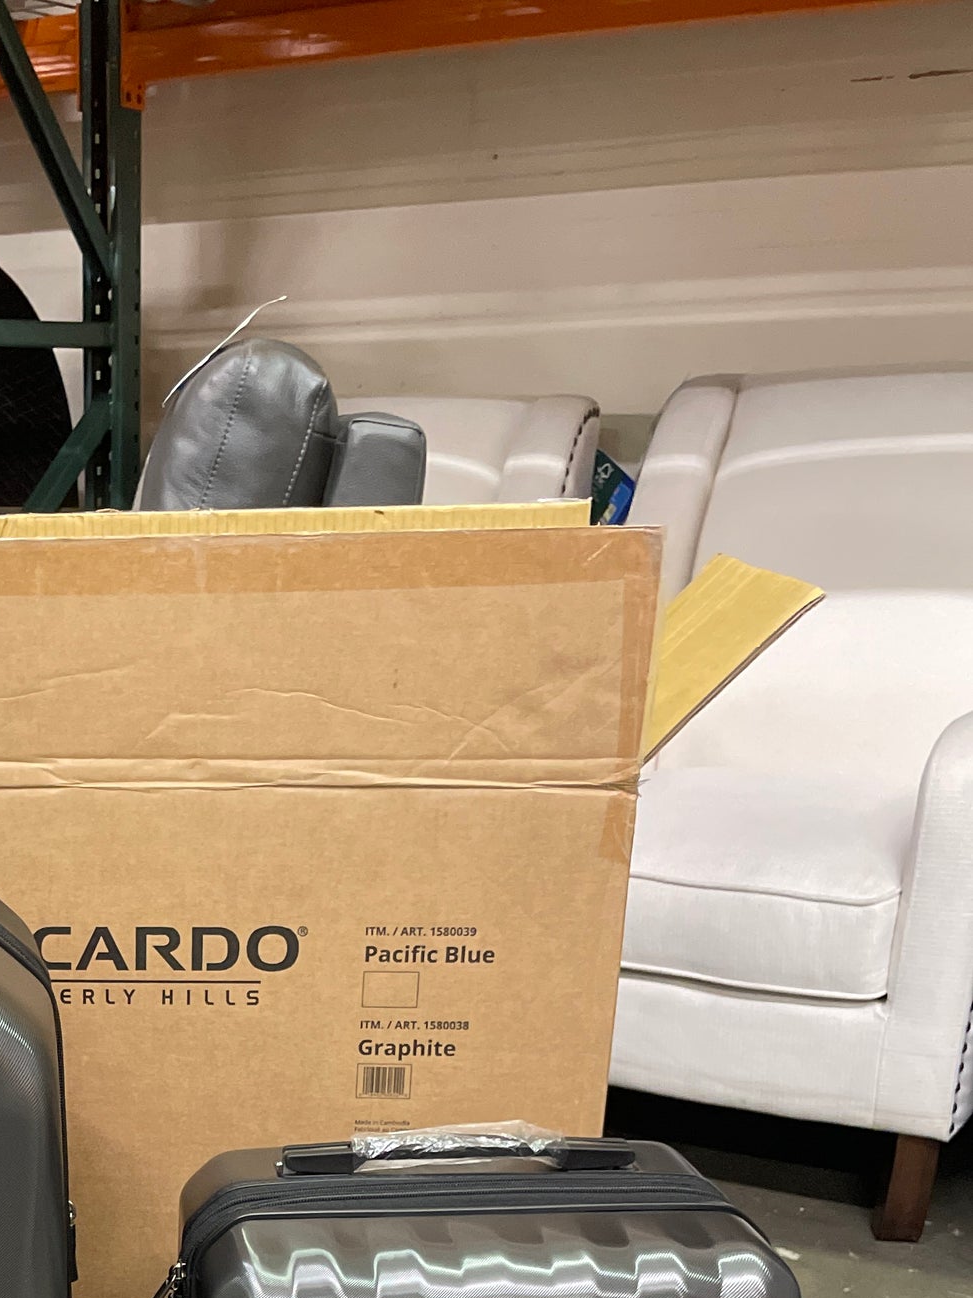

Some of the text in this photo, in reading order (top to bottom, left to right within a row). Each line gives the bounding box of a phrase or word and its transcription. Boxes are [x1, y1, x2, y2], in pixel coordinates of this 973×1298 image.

[365, 926, 477, 937] ITM. / ART. 1580039
[365, 945, 495, 963] Pacific Blue
[161, 989, 260, 1006] HILLS
[360, 1020, 470, 1031] ITM. / ART. 1580038
[358, 1039, 456, 1061] Graphite
